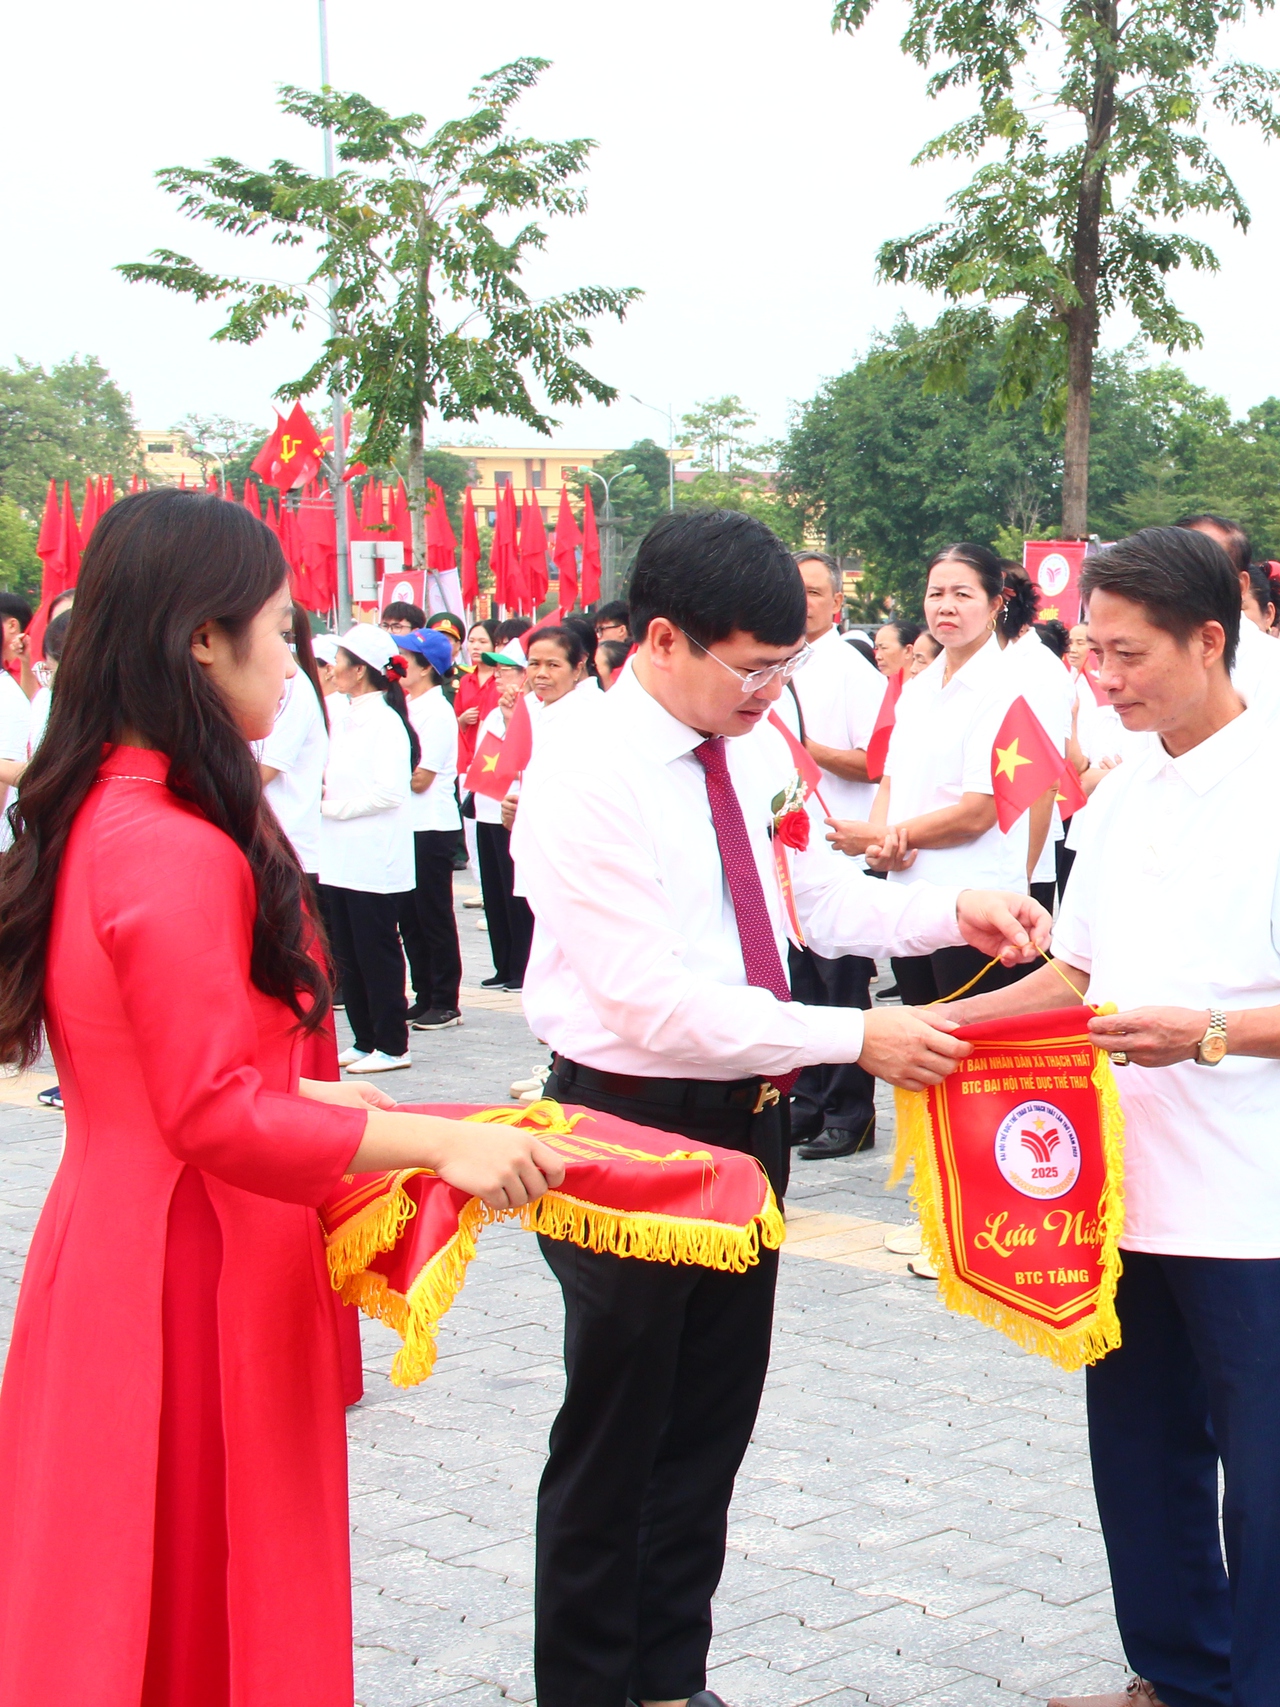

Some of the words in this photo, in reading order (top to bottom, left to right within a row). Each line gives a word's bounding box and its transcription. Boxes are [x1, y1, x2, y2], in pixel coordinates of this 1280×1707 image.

[967, 1057, 988, 1072] BAN
[989, 1054, 1013, 1070] NHÂN
[1014, 1054, 1032, 1069] DÂN
[1032, 1054, 1044, 1068] XÃ
[1044, 1054, 1070, 1070] THẠCH
[1070, 1049, 1091, 1067] THẤT
[962, 1080, 982, 1095] BTC
[984, 1078, 1001, 1095] ĐẠI
[1002, 1075, 1018, 1093] HỘI
[1019, 1072, 1035, 1090] THỂ
[1036, 1076, 1053, 1092] DỤC
[1054, 1070, 1070, 1088] THỂ
[1069, 1076, 1088, 1089] THAO
[1031, 1166, 1058, 1179] 2025
[974, 1211, 1038, 1258] Lưu
[1015, 1272, 1044, 1285] BTC
[1047, 1267, 1090, 1287] TẶNG
